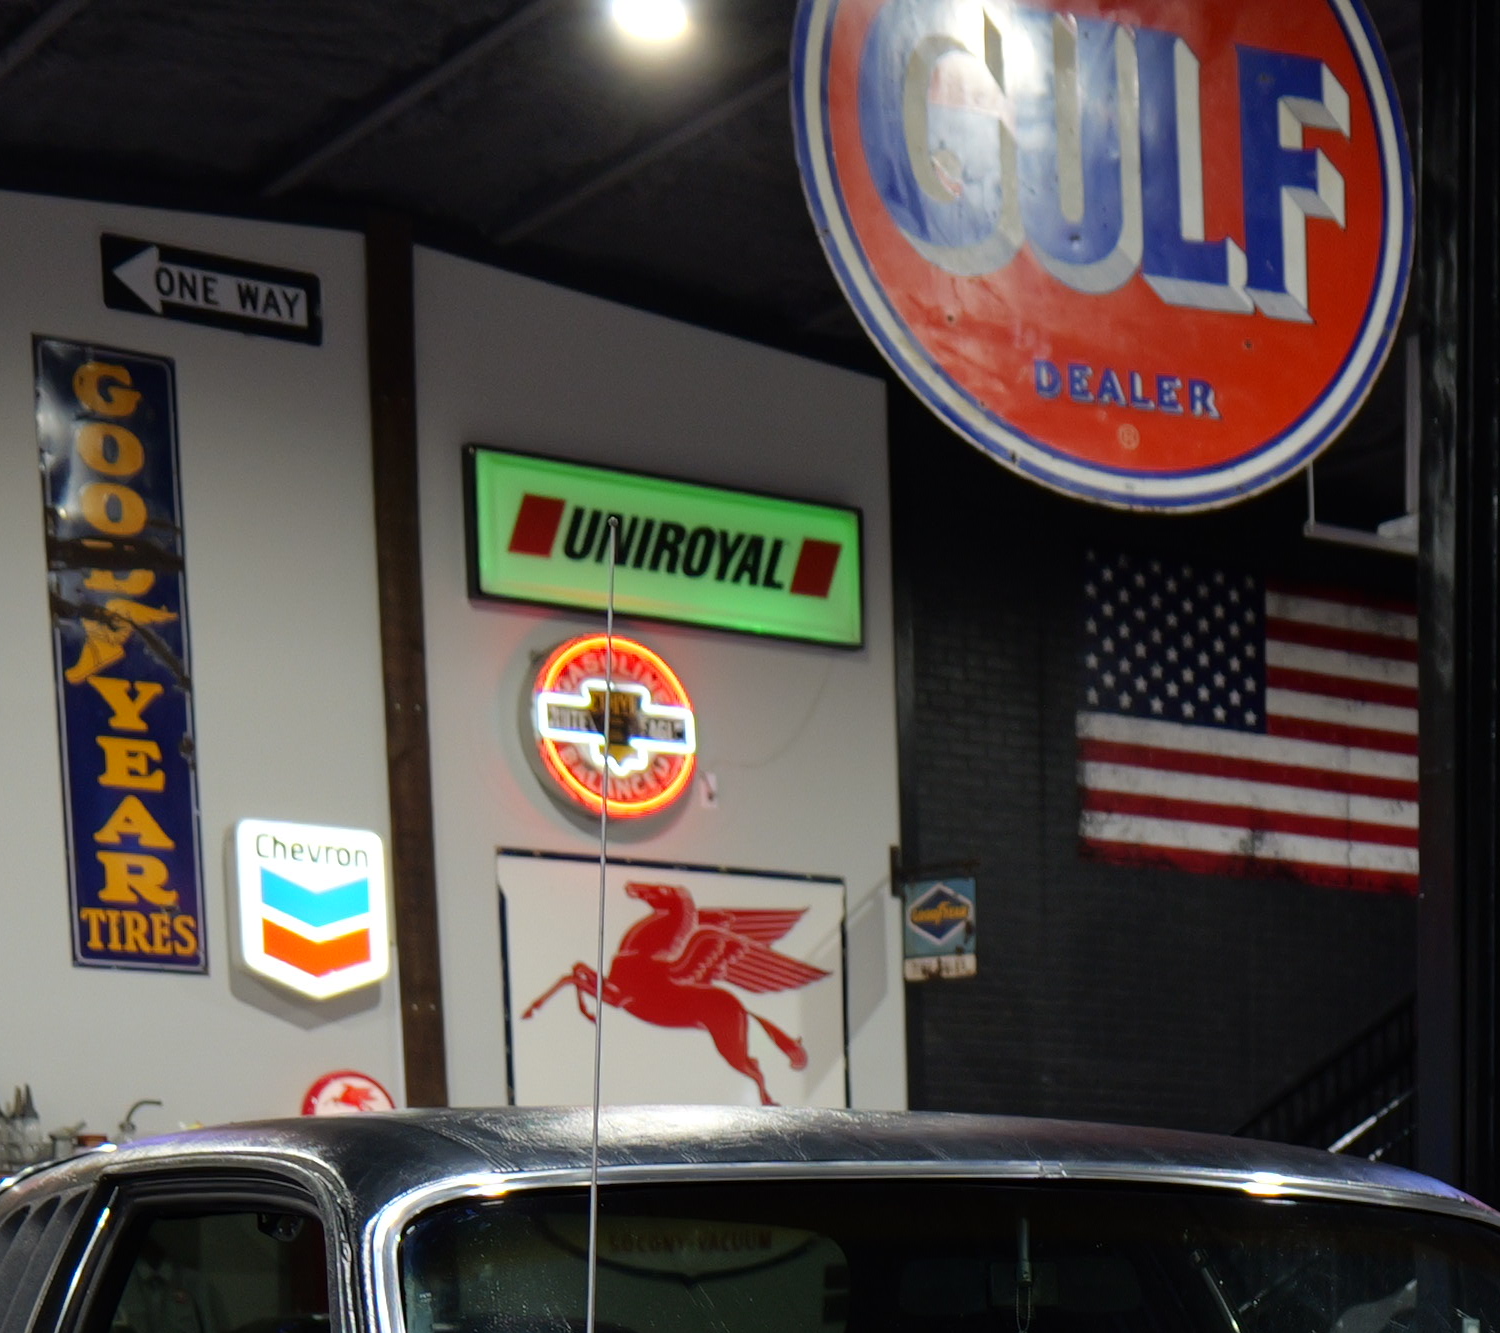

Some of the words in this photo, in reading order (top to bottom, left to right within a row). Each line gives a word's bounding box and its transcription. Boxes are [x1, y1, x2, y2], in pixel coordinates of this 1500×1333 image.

[858, 0, 1350, 323] GULF
[154, 266, 219, 306] ONE
[238, 281, 303, 320] WAY
[1034, 358, 1222, 420] DEALER
[562, 506, 791, 592] UNIROYAL
[256, 833, 369, 868] Chevron
[79, 907, 199, 957] TIRES
